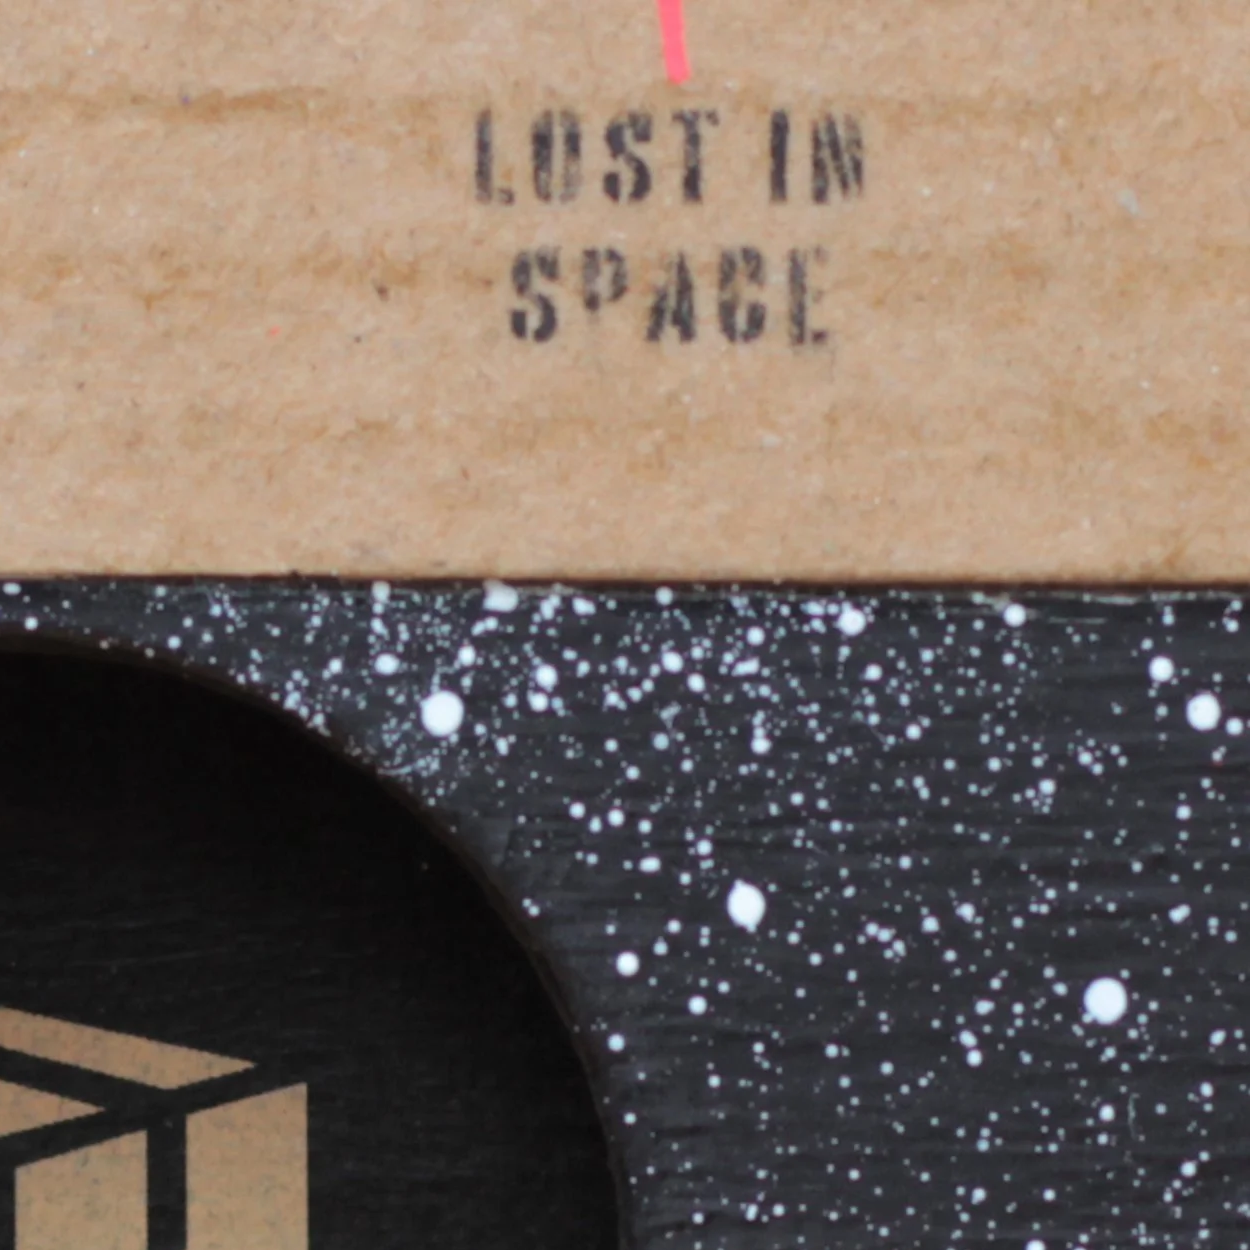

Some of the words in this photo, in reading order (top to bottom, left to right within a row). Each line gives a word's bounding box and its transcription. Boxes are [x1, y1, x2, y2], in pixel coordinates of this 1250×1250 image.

[473, 108, 720, 205] LOST
[769, 107, 865, 205] IN
[509, 246, 829, 346] SPACE
